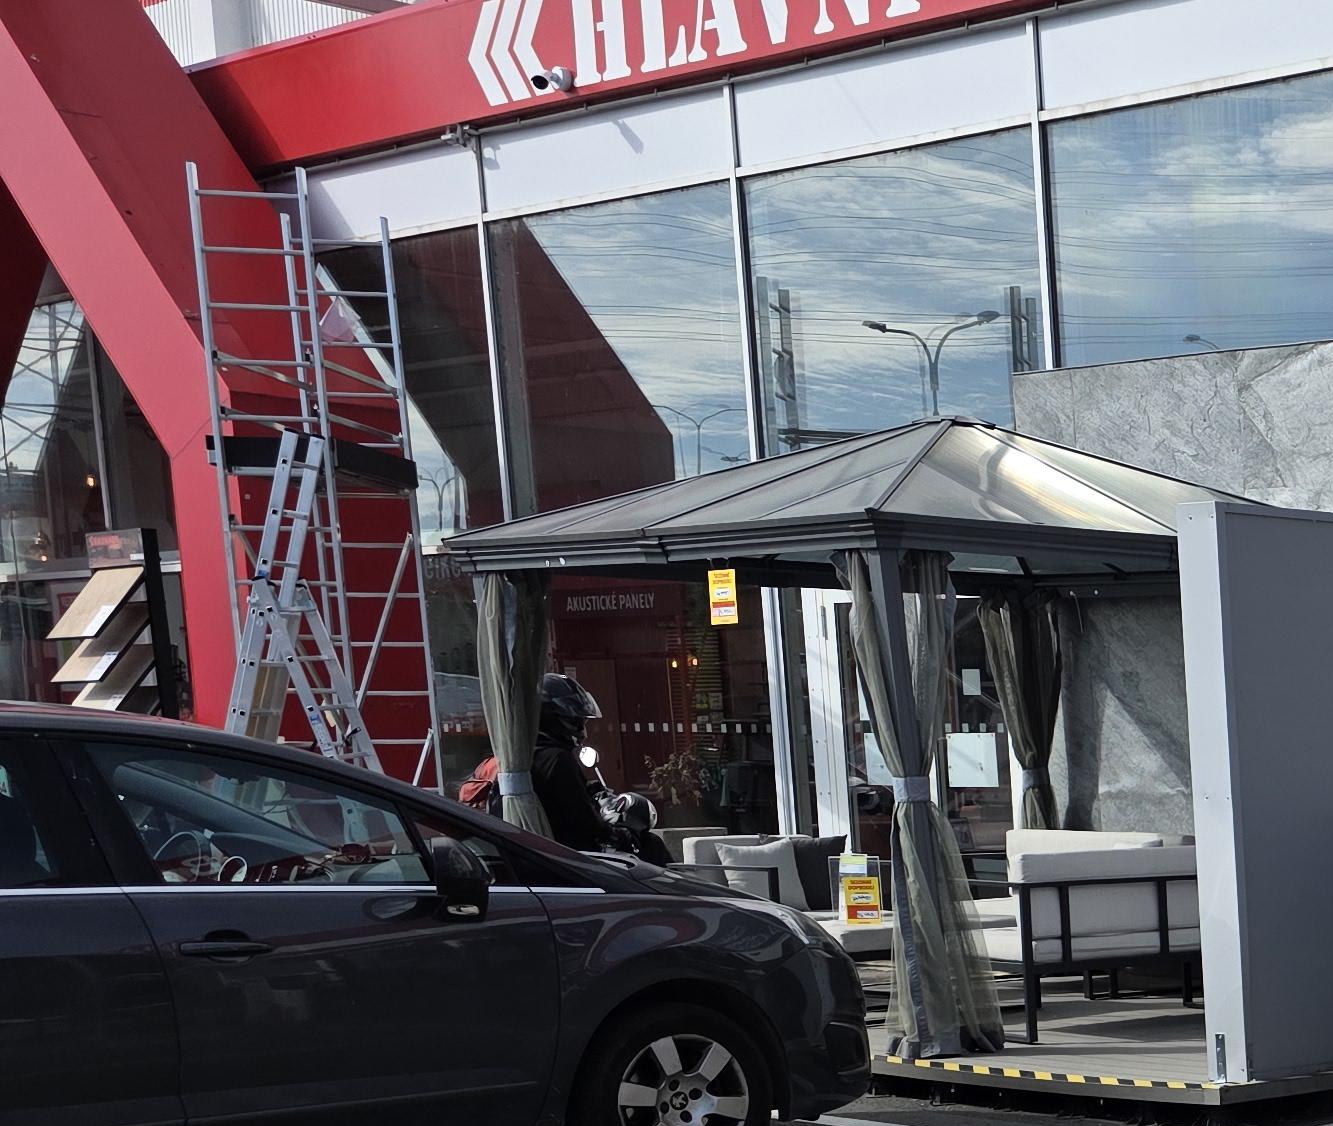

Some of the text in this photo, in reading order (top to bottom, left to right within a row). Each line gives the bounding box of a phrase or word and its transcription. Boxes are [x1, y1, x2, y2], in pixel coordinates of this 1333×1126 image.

[571, 0, 920, 87] HLA
[566, 591, 655, 611] AKUSTICKÉ PANELY
